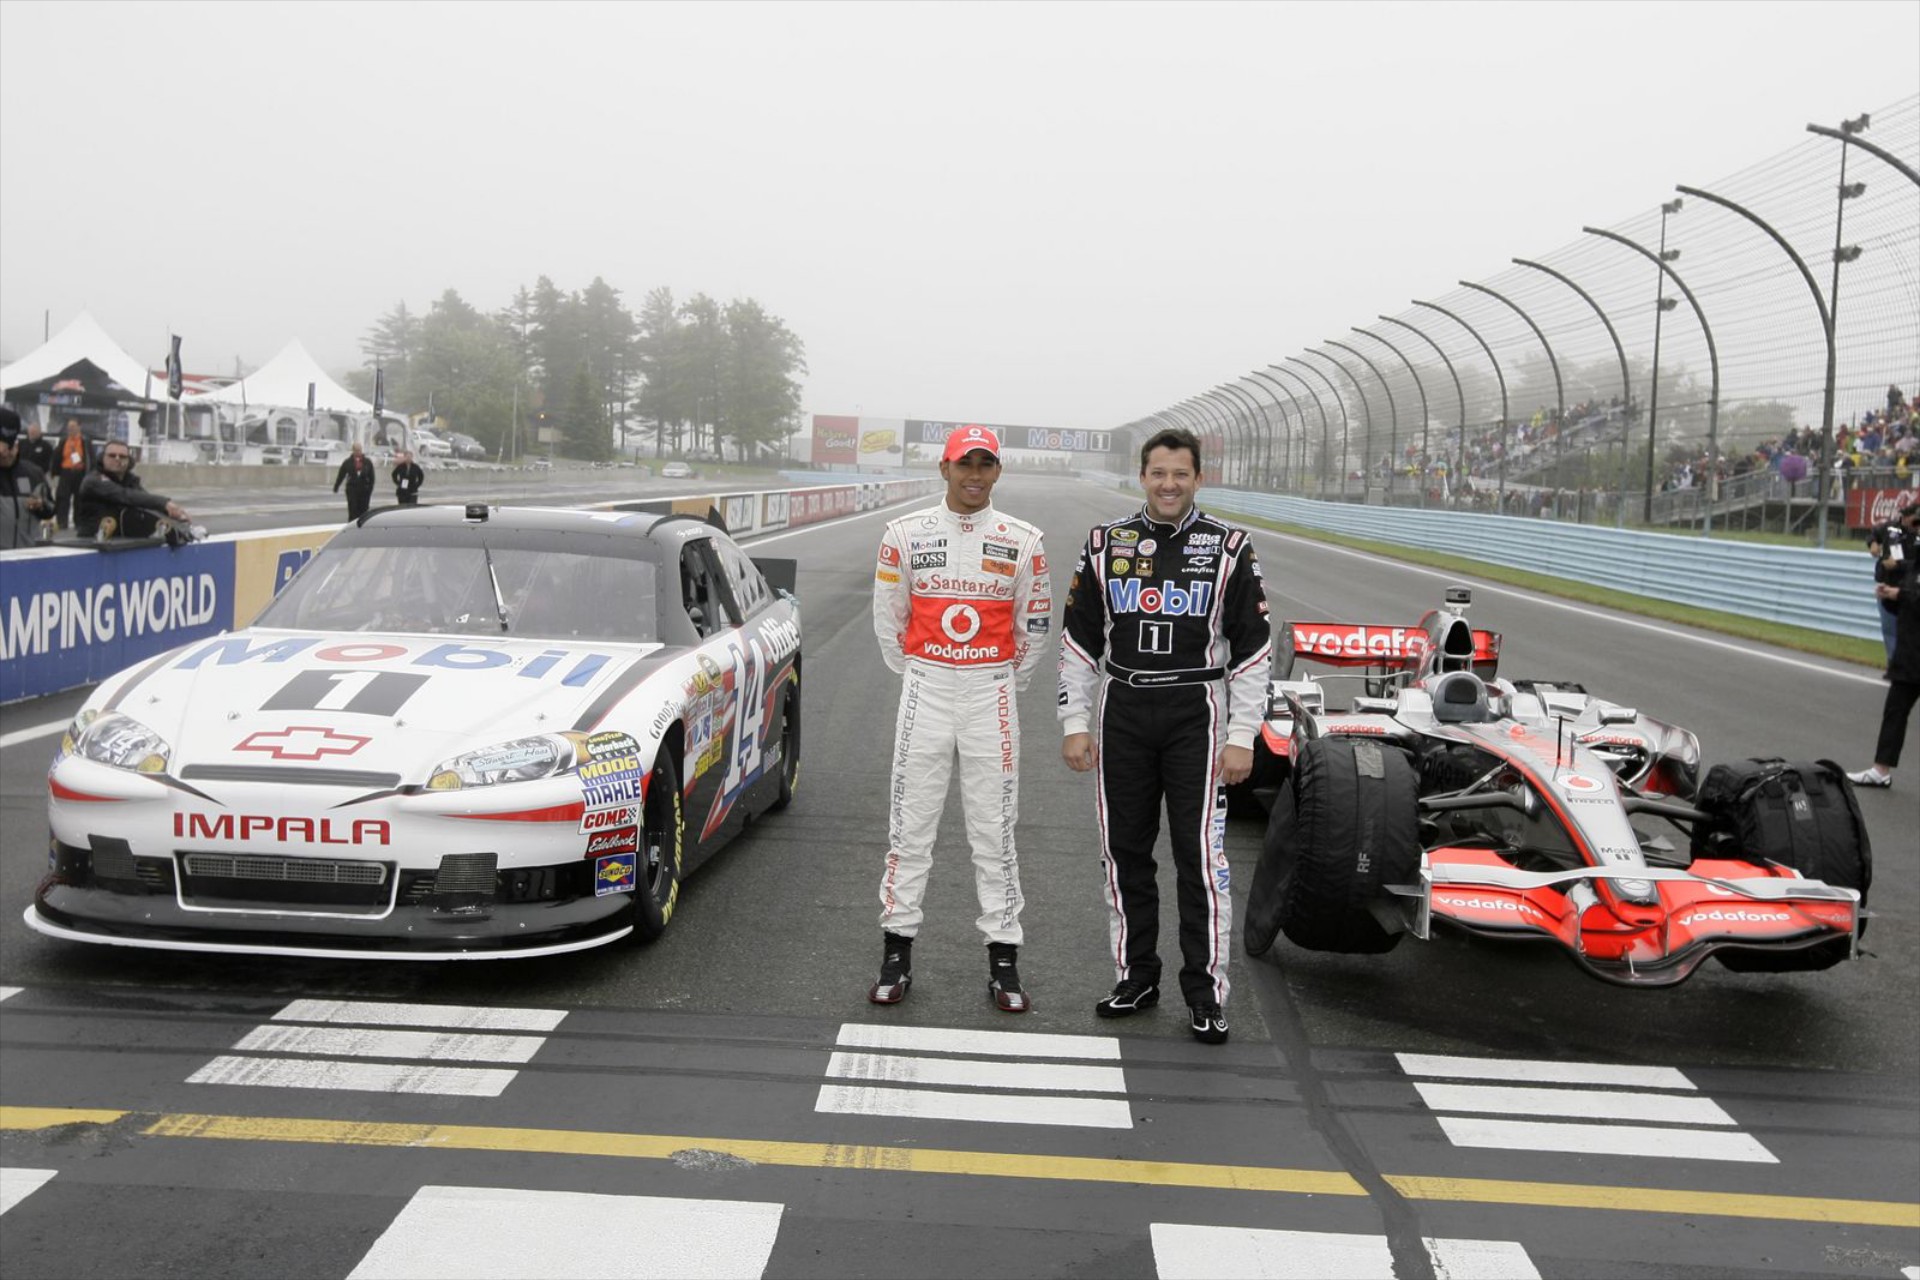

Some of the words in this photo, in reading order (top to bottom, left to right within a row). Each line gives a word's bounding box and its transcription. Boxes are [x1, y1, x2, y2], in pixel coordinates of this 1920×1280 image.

[1028, 428, 1088, 450] Mobil
[911, 540, 937, 551] Mobil
[984, 534, 1019, 546] vodafone
[912, 553, 945, 565] BOSS
[931, 574, 1011, 596] Santander
[120, 573, 216, 636] WORLD
[1108, 578, 1212, 616] Mobil
[758, 618, 800, 664] Office
[924, 642, 999, 660] vodafone
[174, 638, 612, 687] Mobil
[314, 671, 380, 709] 1
[723, 639, 766, 798] 14
[898, 680, 920, 768] MERCEDES
[998, 683, 1013, 774] VODAFONE
[1327, 725, 1386, 735] vodafone
[1583, 735, 1643, 746] vodafone
[587, 737, 635, 755] Gatorback
[596, 747, 637, 760] BELTS
[579, 756, 638, 780] MOOG
[581, 780, 641, 806] MAHLE
[174, 812, 390, 846] IMPALA
[584, 808, 627, 829] COMP
[588, 832, 636, 853] Edelbrock
[1601, 847, 1638, 855] Mobil
[1357, 853, 1371, 873] RF
[1438, 896, 1544, 920] vodafone
[1678, 910, 1792, 927] vodafone
